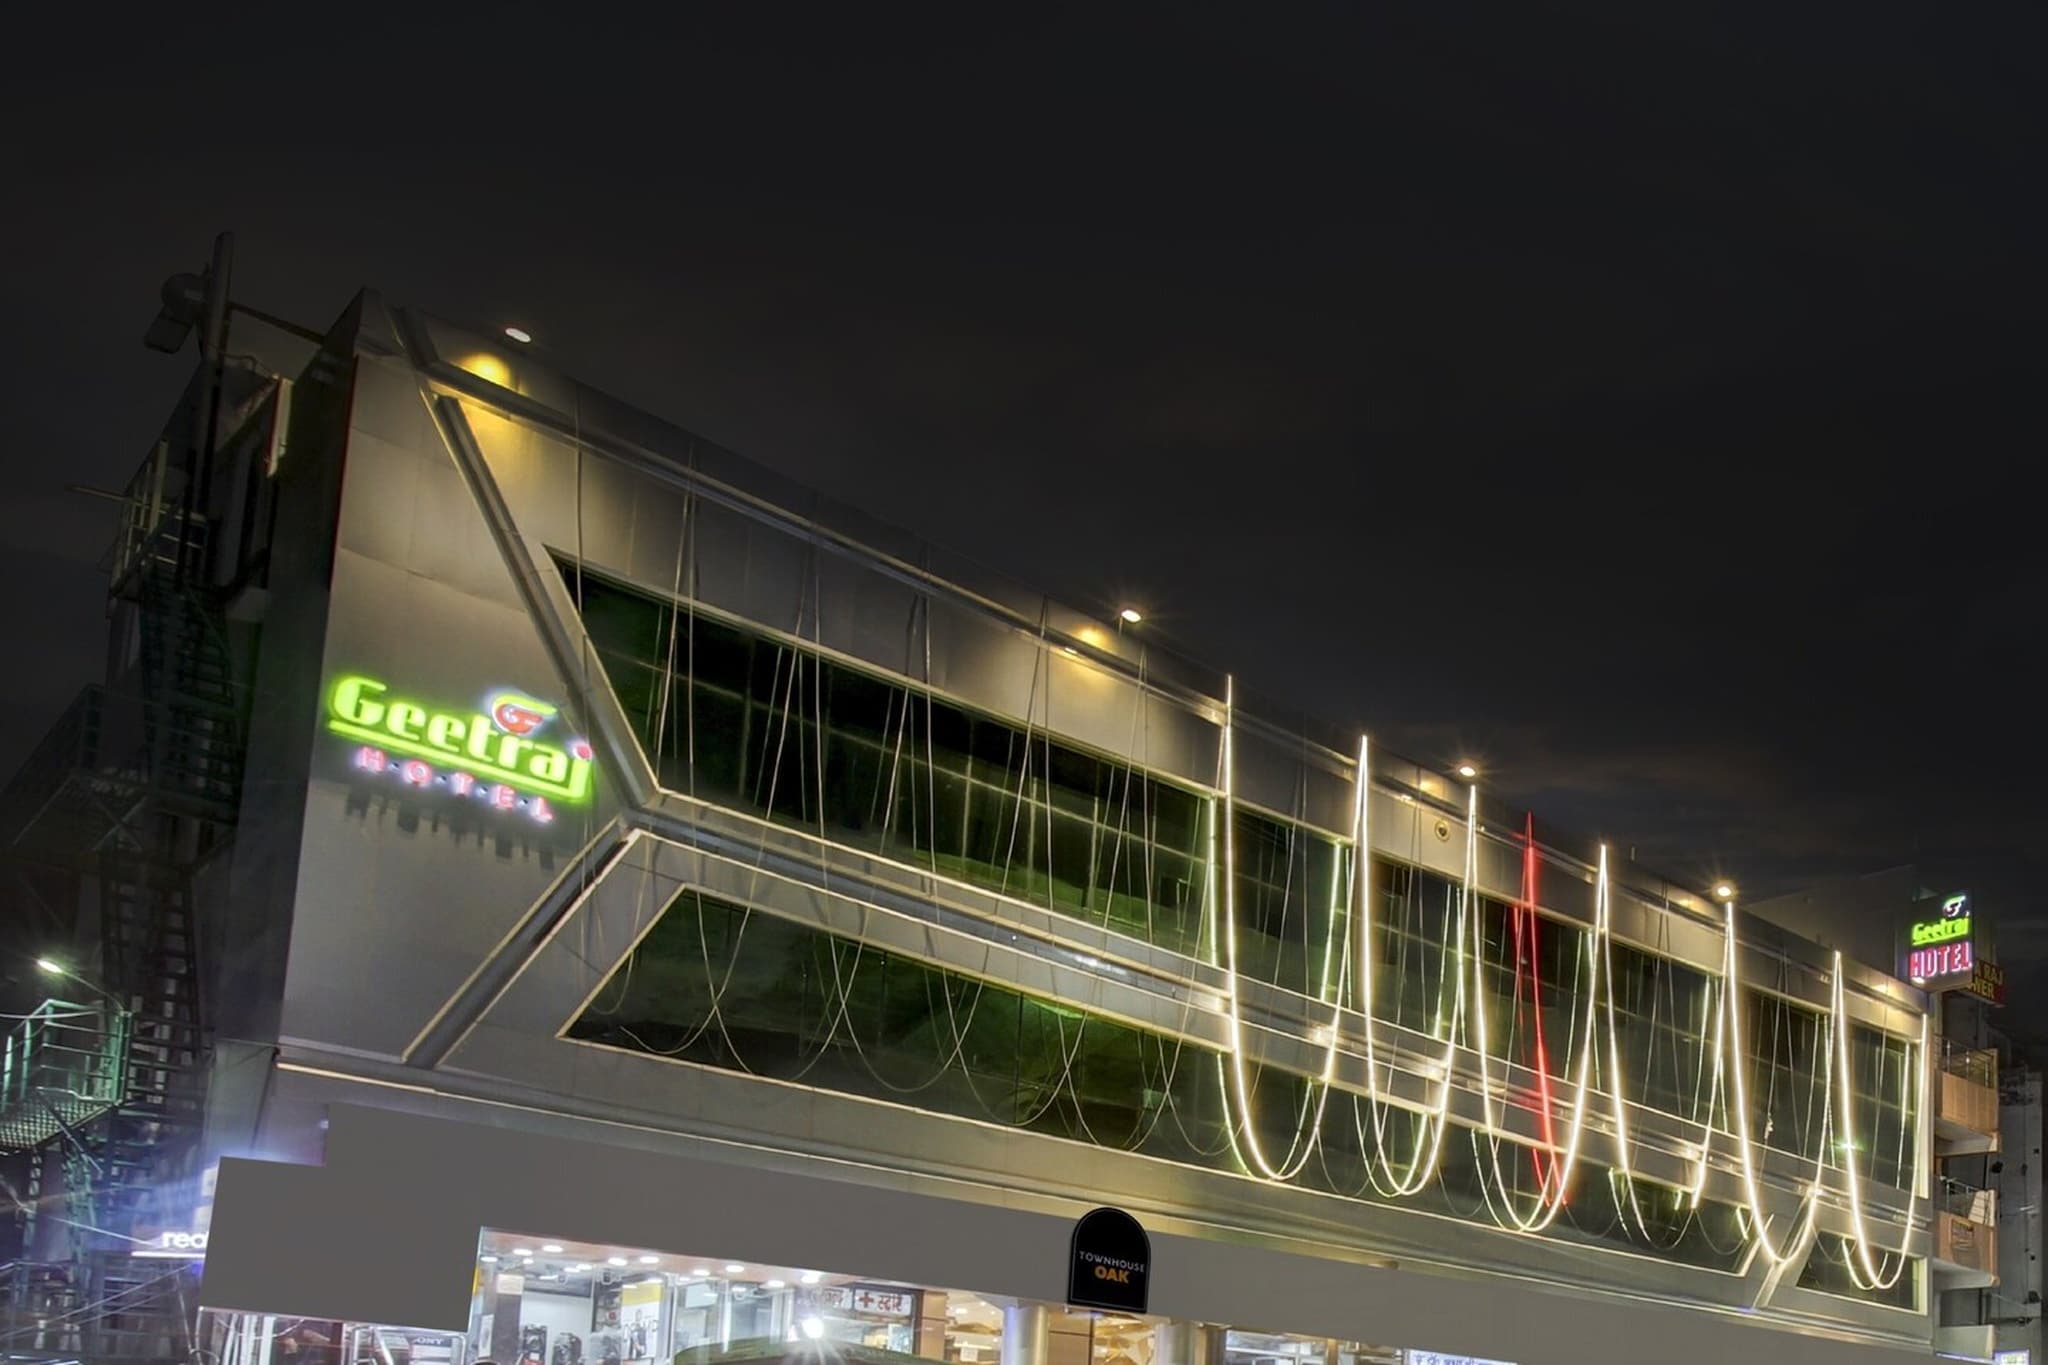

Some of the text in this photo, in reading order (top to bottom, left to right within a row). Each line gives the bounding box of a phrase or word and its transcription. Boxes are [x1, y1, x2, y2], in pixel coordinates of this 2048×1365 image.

[329, 676, 593, 799] Geetraj
[1910, 942, 1973, 977] HOTEL
[1079, 1250, 1145, 1273] TOWNHOUSE
[1094, 1265, 1130, 1284] OAK
